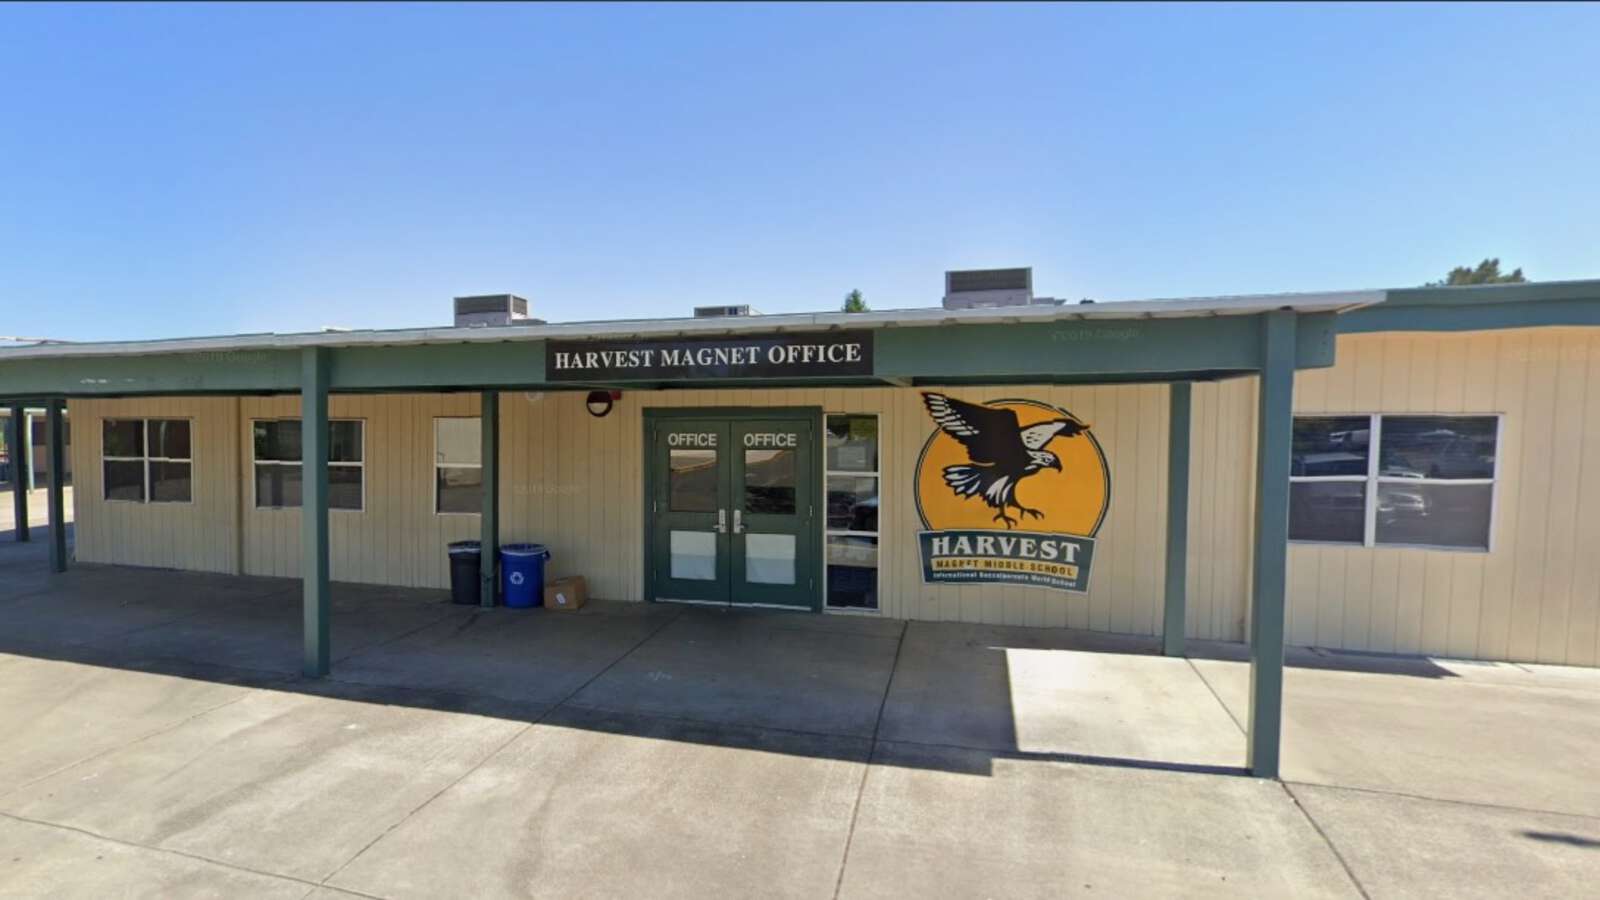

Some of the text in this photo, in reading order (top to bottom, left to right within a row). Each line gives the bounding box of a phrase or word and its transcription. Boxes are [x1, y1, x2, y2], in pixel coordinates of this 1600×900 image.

[555, 343, 861, 369] HARVEST MAGNET OFFICE
[667, 433, 717, 446] OFFICE
[743, 433, 797, 447] OFFICE
[931, 535, 1081, 563] HARVEST
[984, 559, 1025, 570] MIDDLE
[1030, 561, 1074, 576] SCHOOL
[1051, 577, 1076, 588] School
